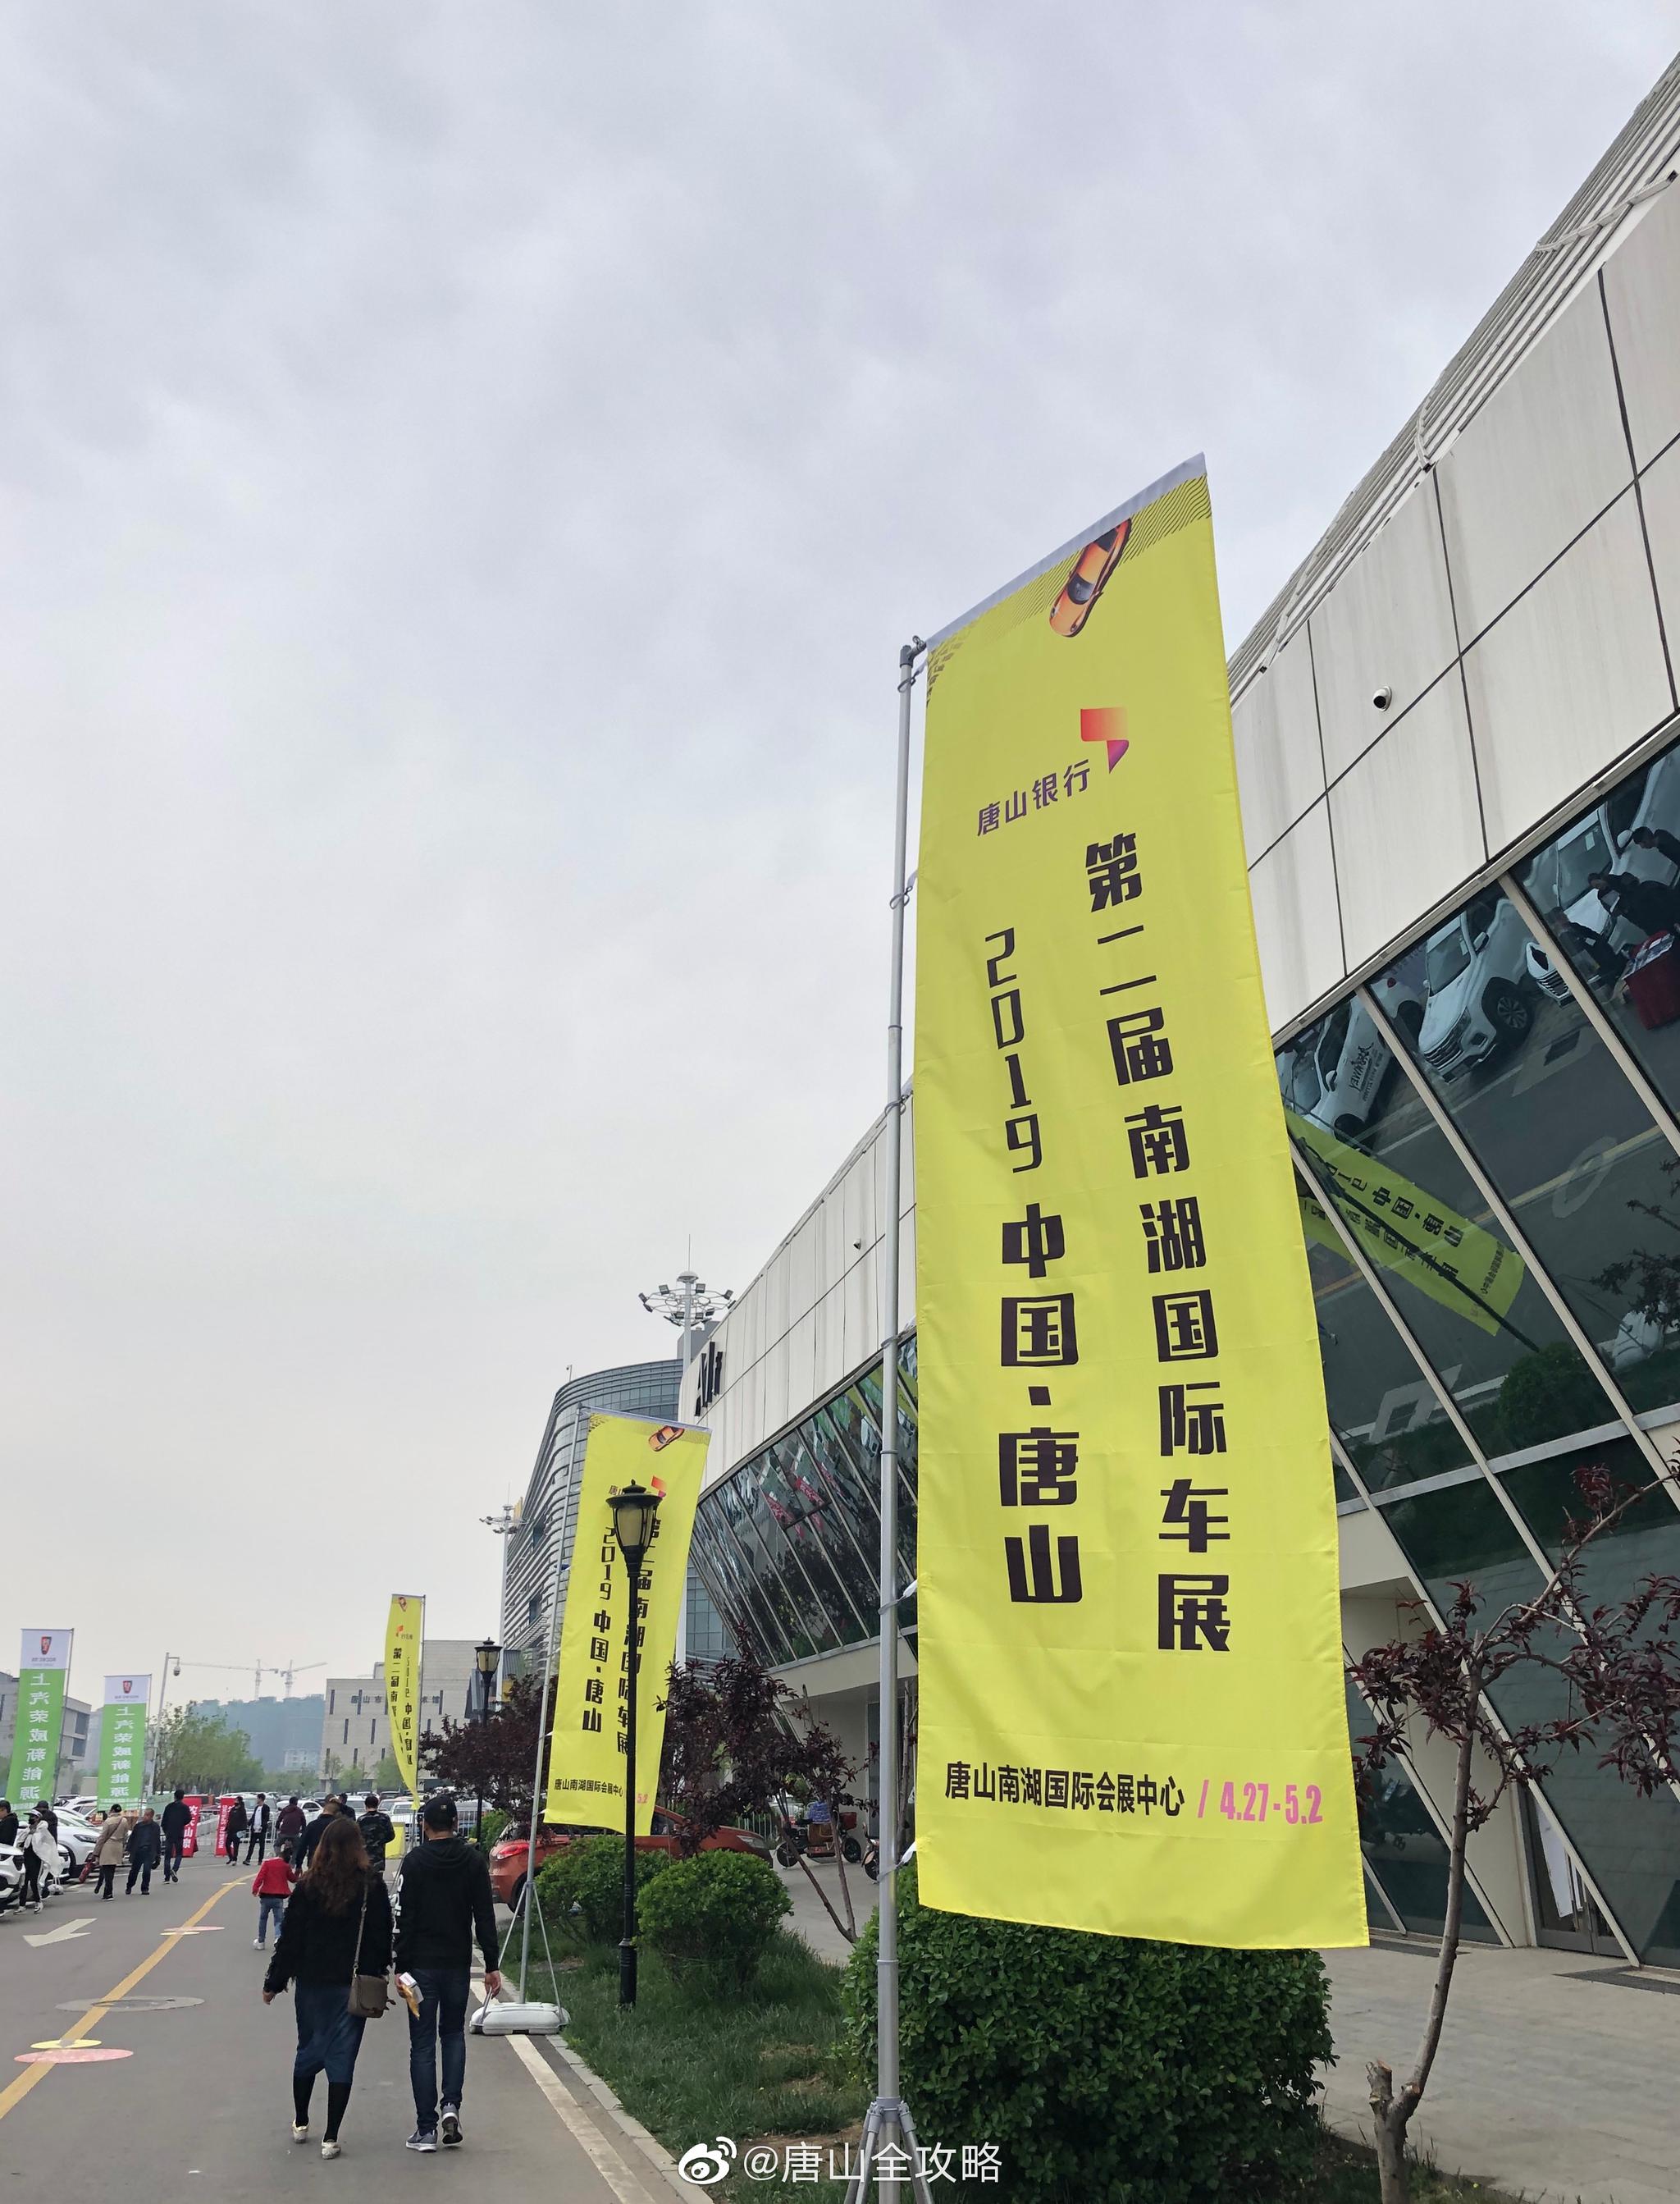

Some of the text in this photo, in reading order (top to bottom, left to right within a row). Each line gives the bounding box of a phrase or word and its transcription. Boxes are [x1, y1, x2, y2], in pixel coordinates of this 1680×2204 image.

[976, 758, 1091, 837] 唐山银行
[984, 927, 1043, 1173] 2019
[1085, 832, 1230, 1653] 第二届南湖国际车展
[600, 1526, 616, 1601] 2019
[554, 1778, 623, 1798] 唐山南湖国际会展中心
[945, 1760, 1185, 1818] 唐山南湖国际会展中心
[1220, 1781, 1323, 1825] 4.27-5.2
